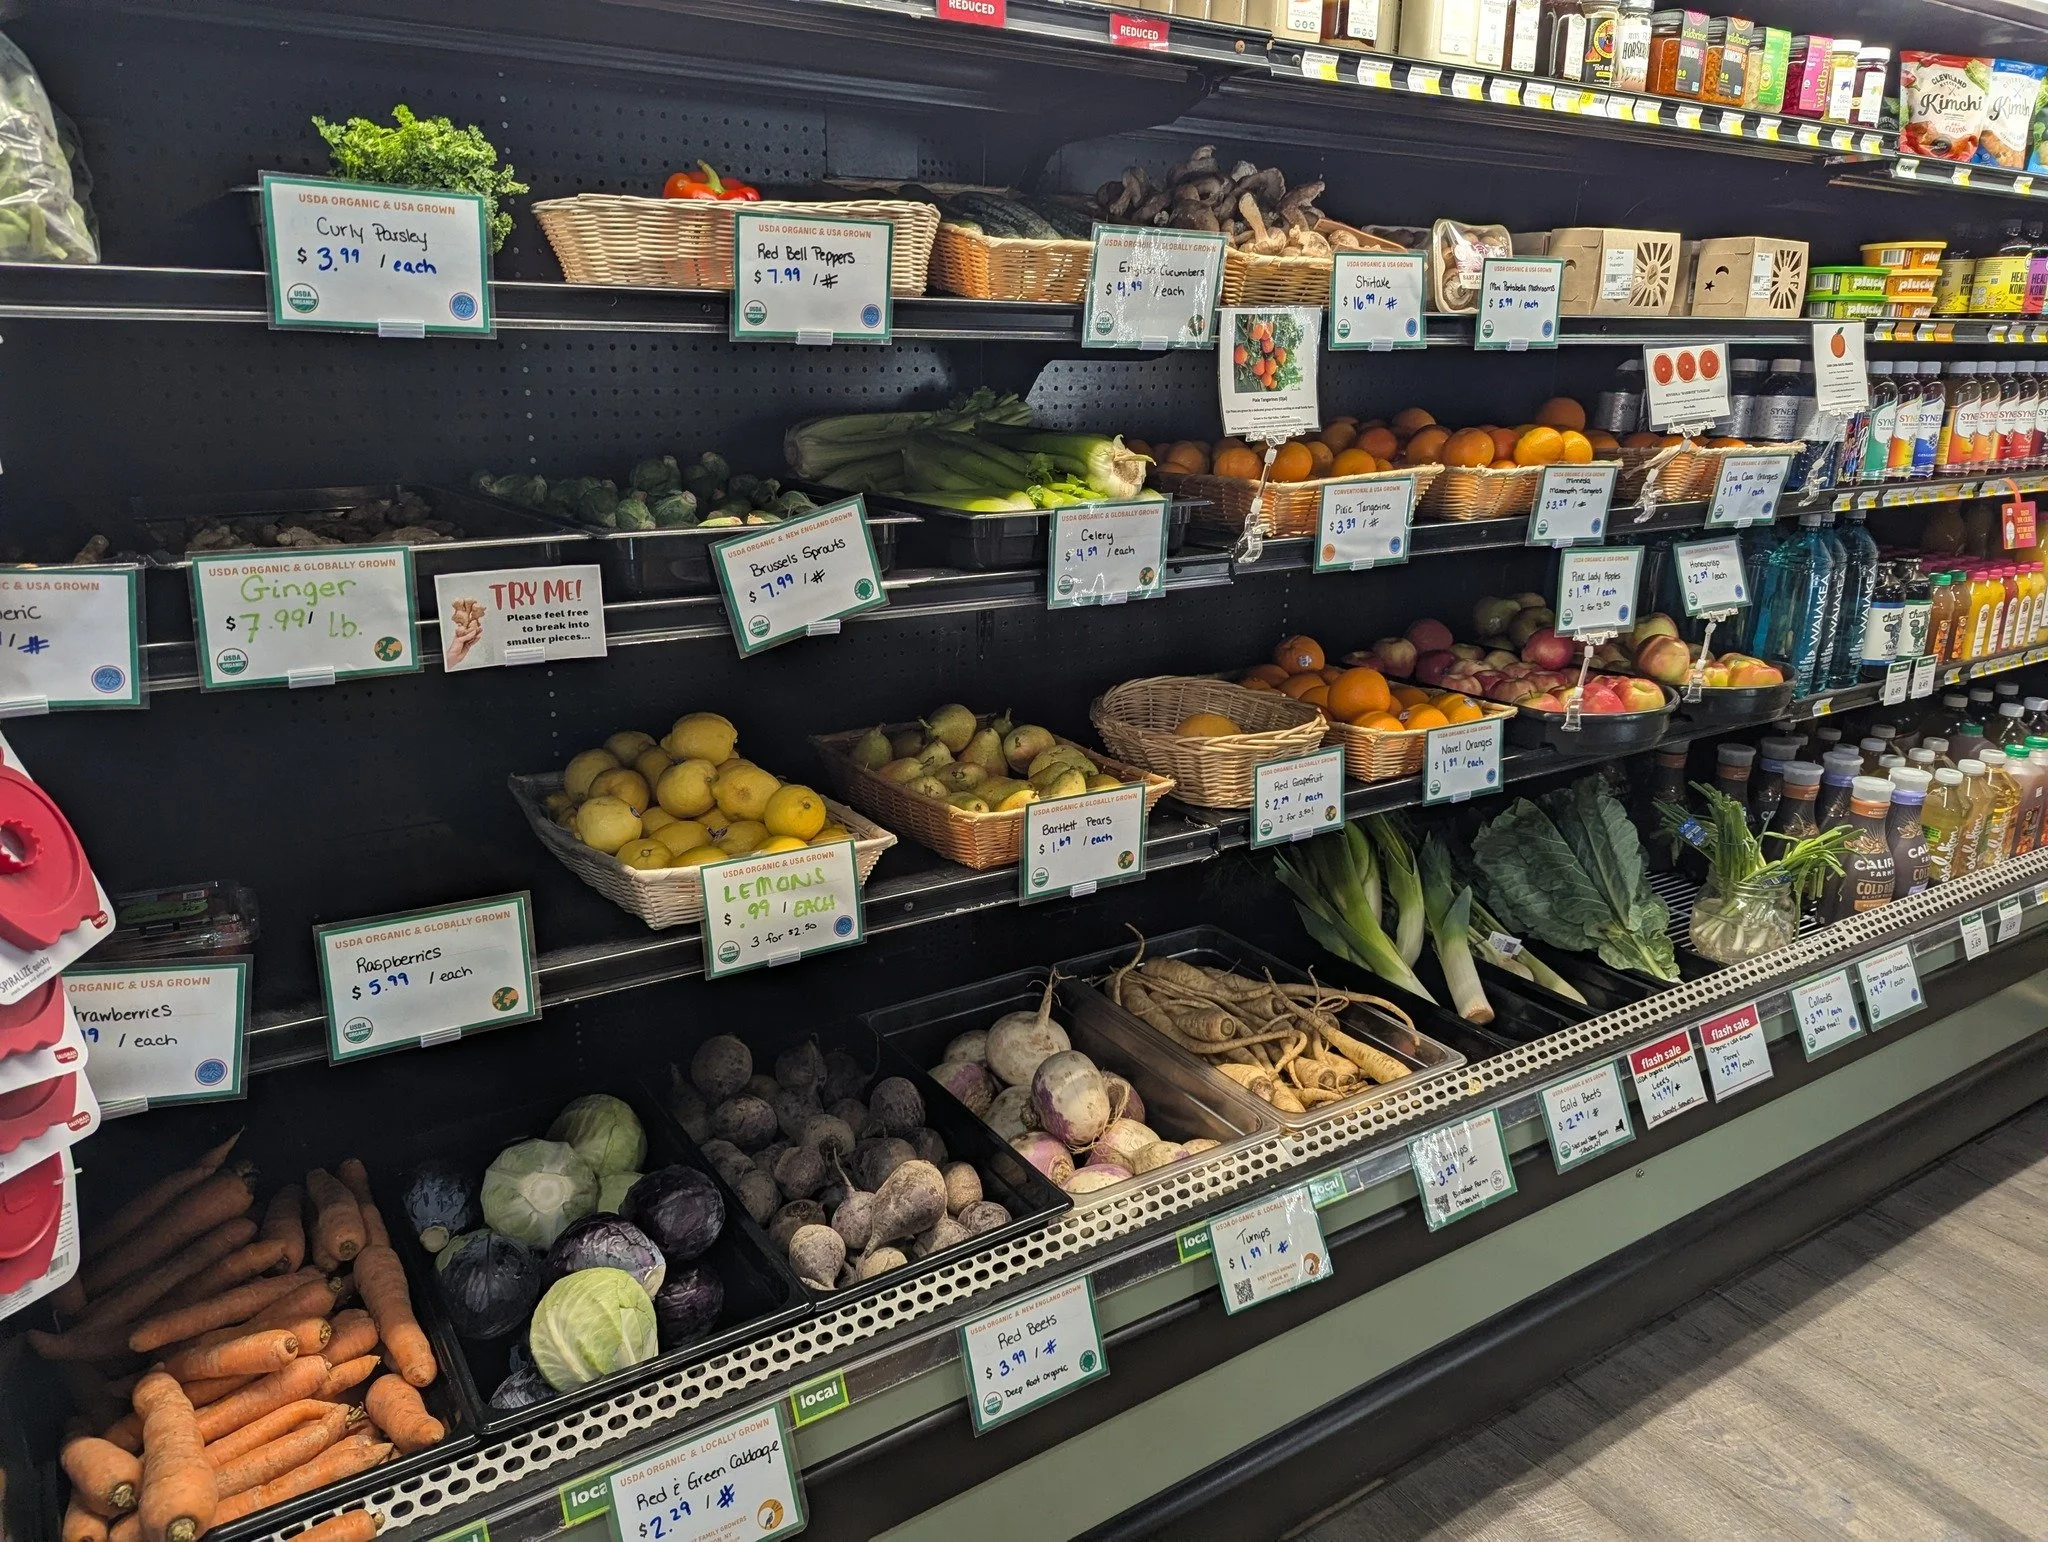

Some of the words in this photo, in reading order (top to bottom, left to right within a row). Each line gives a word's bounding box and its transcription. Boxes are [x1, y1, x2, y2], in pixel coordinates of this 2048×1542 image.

[949, 0, 995, 15] REDUCED
[1120, 25, 1158, 40] REDUCED
[1817, 41, 1833, 107] wildbrine
[1932, 74, 1967, 88] CLEVELAND
[1918, 94, 1982, 116] Kimchi
[299, 194, 328, 204] USDA
[331, 196, 380, 208] ORGANIC
[394, 202, 414, 211] USA
[417, 203, 456, 214] GROWN
[317, 217, 363, 243] Curly
[372, 223, 427, 251] Parsley
[759, 224, 780, 232] USDA
[782, 226, 816, 235] ORGANIC
[843, 230, 871, 238] GROWN
[758, 243, 778, 260] Red
[786, 246, 807, 260] Bell
[811, 246, 855, 268] Peppers
[393, 259, 437, 274] each
[1160, 265, 1205, 277] Cucumbers
[1161, 287, 1184, 296] each
[1898, 279, 1935, 291] plucky
[1524, 300, 1538, 309] each
[1757, 473, 1778, 483] Oranges
[1752, 487, 1764, 496] each
[1357, 501, 1392, 516] Tangerine
[728, 549, 746, 558] USDA
[747, 538, 775, 552] ORGANIC
[786, 531, 799, 539] NEW
[801, 520, 829, 534] ENGLAND
[830, 512, 853, 524] GROWN
[1081, 529, 1114, 545] Celery
[750, 554, 798, 577] Brussels
[803, 538, 846, 560] Sprouts
[1115, 546, 1135, 555] each
[209, 567, 239, 577] USDA
[242, 564, 290, 575] ORGANIC
[304, 561, 355, 571] GLOBALLY
[358, 559, 396, 569] GROWN
[1572, 572, 1585, 582] Pink
[1588, 572, 1600, 582] Lady
[1605, 572, 1620, 582] Apples
[27, 582, 50, 590] USA
[54, 582, 99, 590] GROWN
[241, 575, 356, 607] Ginger
[489, 581, 537, 610] TRY
[543, 579, 582, 604] ME!
[1858, 564, 1877, 634] WAIAKEA
[507, 613, 542, 622] Please
[545, 610, 565, 618] feel
[567, 609, 589, 617] free
[1809, 573, 1830, 646] WAIAKEA
[536, 623, 565, 631] break
[568, 621, 590, 629] into
[507, 636, 546, 646] smaller
[549, 633, 591, 644] pieces...
[1442, 741, 1461, 754] Navel
[1466, 738, 1492, 752] Oranges
[1467, 757, 1483, 768] each
[1274, 782, 1288, 791] Red
[1292, 773, 1324, 787] Grapefruit
[1305, 792, 1323, 802] each
[1042, 820, 1077, 836] Bartlett
[1086, 816, 1112, 826] Pears
[1091, 834, 1113, 845] each
[723, 869, 744, 879] USDA
[745, 862, 780, 874] ORGANIC
[806, 851, 834, 862] GROWN
[723, 867, 825, 903] LEMONS
[793, 894, 836, 918] EACH
[335, 939, 363, 949] USDA
[366, 928, 411, 944] ORGANIC
[424, 917, 472, 933] GLOBALLY
[475, 911, 511, 923] GROWN
[765, 932, 784, 943] for
[356, 947, 442, 974] Raspberries
[0, 964, 32, 994] SPIRALIZE
[32, 956, 50, 972] quickly
[440, 966, 473, 982] each
[69, 981, 125, 992] ORGANIC
[141, 979, 163, 988] USA
[167, 977, 211, 987] GROWN
[1809, 993, 1832, 1008] Collards
[74, 1004, 172, 1023] trawberries
[1711, 1028, 1732, 1040] flash
[1734, 1018, 1750, 1031] sale
[134, 1034, 178, 1048] each
[1642, 1054, 1663, 1069] flash
[1665, 1045, 1681, 1059] sale
[1652, 1077, 1670, 1090] Leeks
[1560, 1097, 1578, 1112] Gold
[1581, 1088, 1601, 1103] Beets
[1312, 1177, 1339, 1196] local
[1236, 1227, 1271, 1245] Turnips
[997, 1328, 1022, 1350] Red
[1028, 1314, 1058, 1336] Beets
[1005, 1385, 1023, 1398] Deep
[1026, 1377, 1040, 1388] Root
[1043, 1364, 1069, 1381] Organic
[800, 1380, 839, 1410] local
[620, 1471, 646, 1487] USDA
[647, 1453, 686, 1476] ORGANIC
[700, 1430, 738, 1452] LOCALLY
[739, 1418, 770, 1437] GROWN
[636, 1486, 668, 1511] Red
[687, 1466, 726, 1490] Green
[729, 1439, 780, 1469] Cabbage
[720, 1516, 747, 1533] GROWERS
